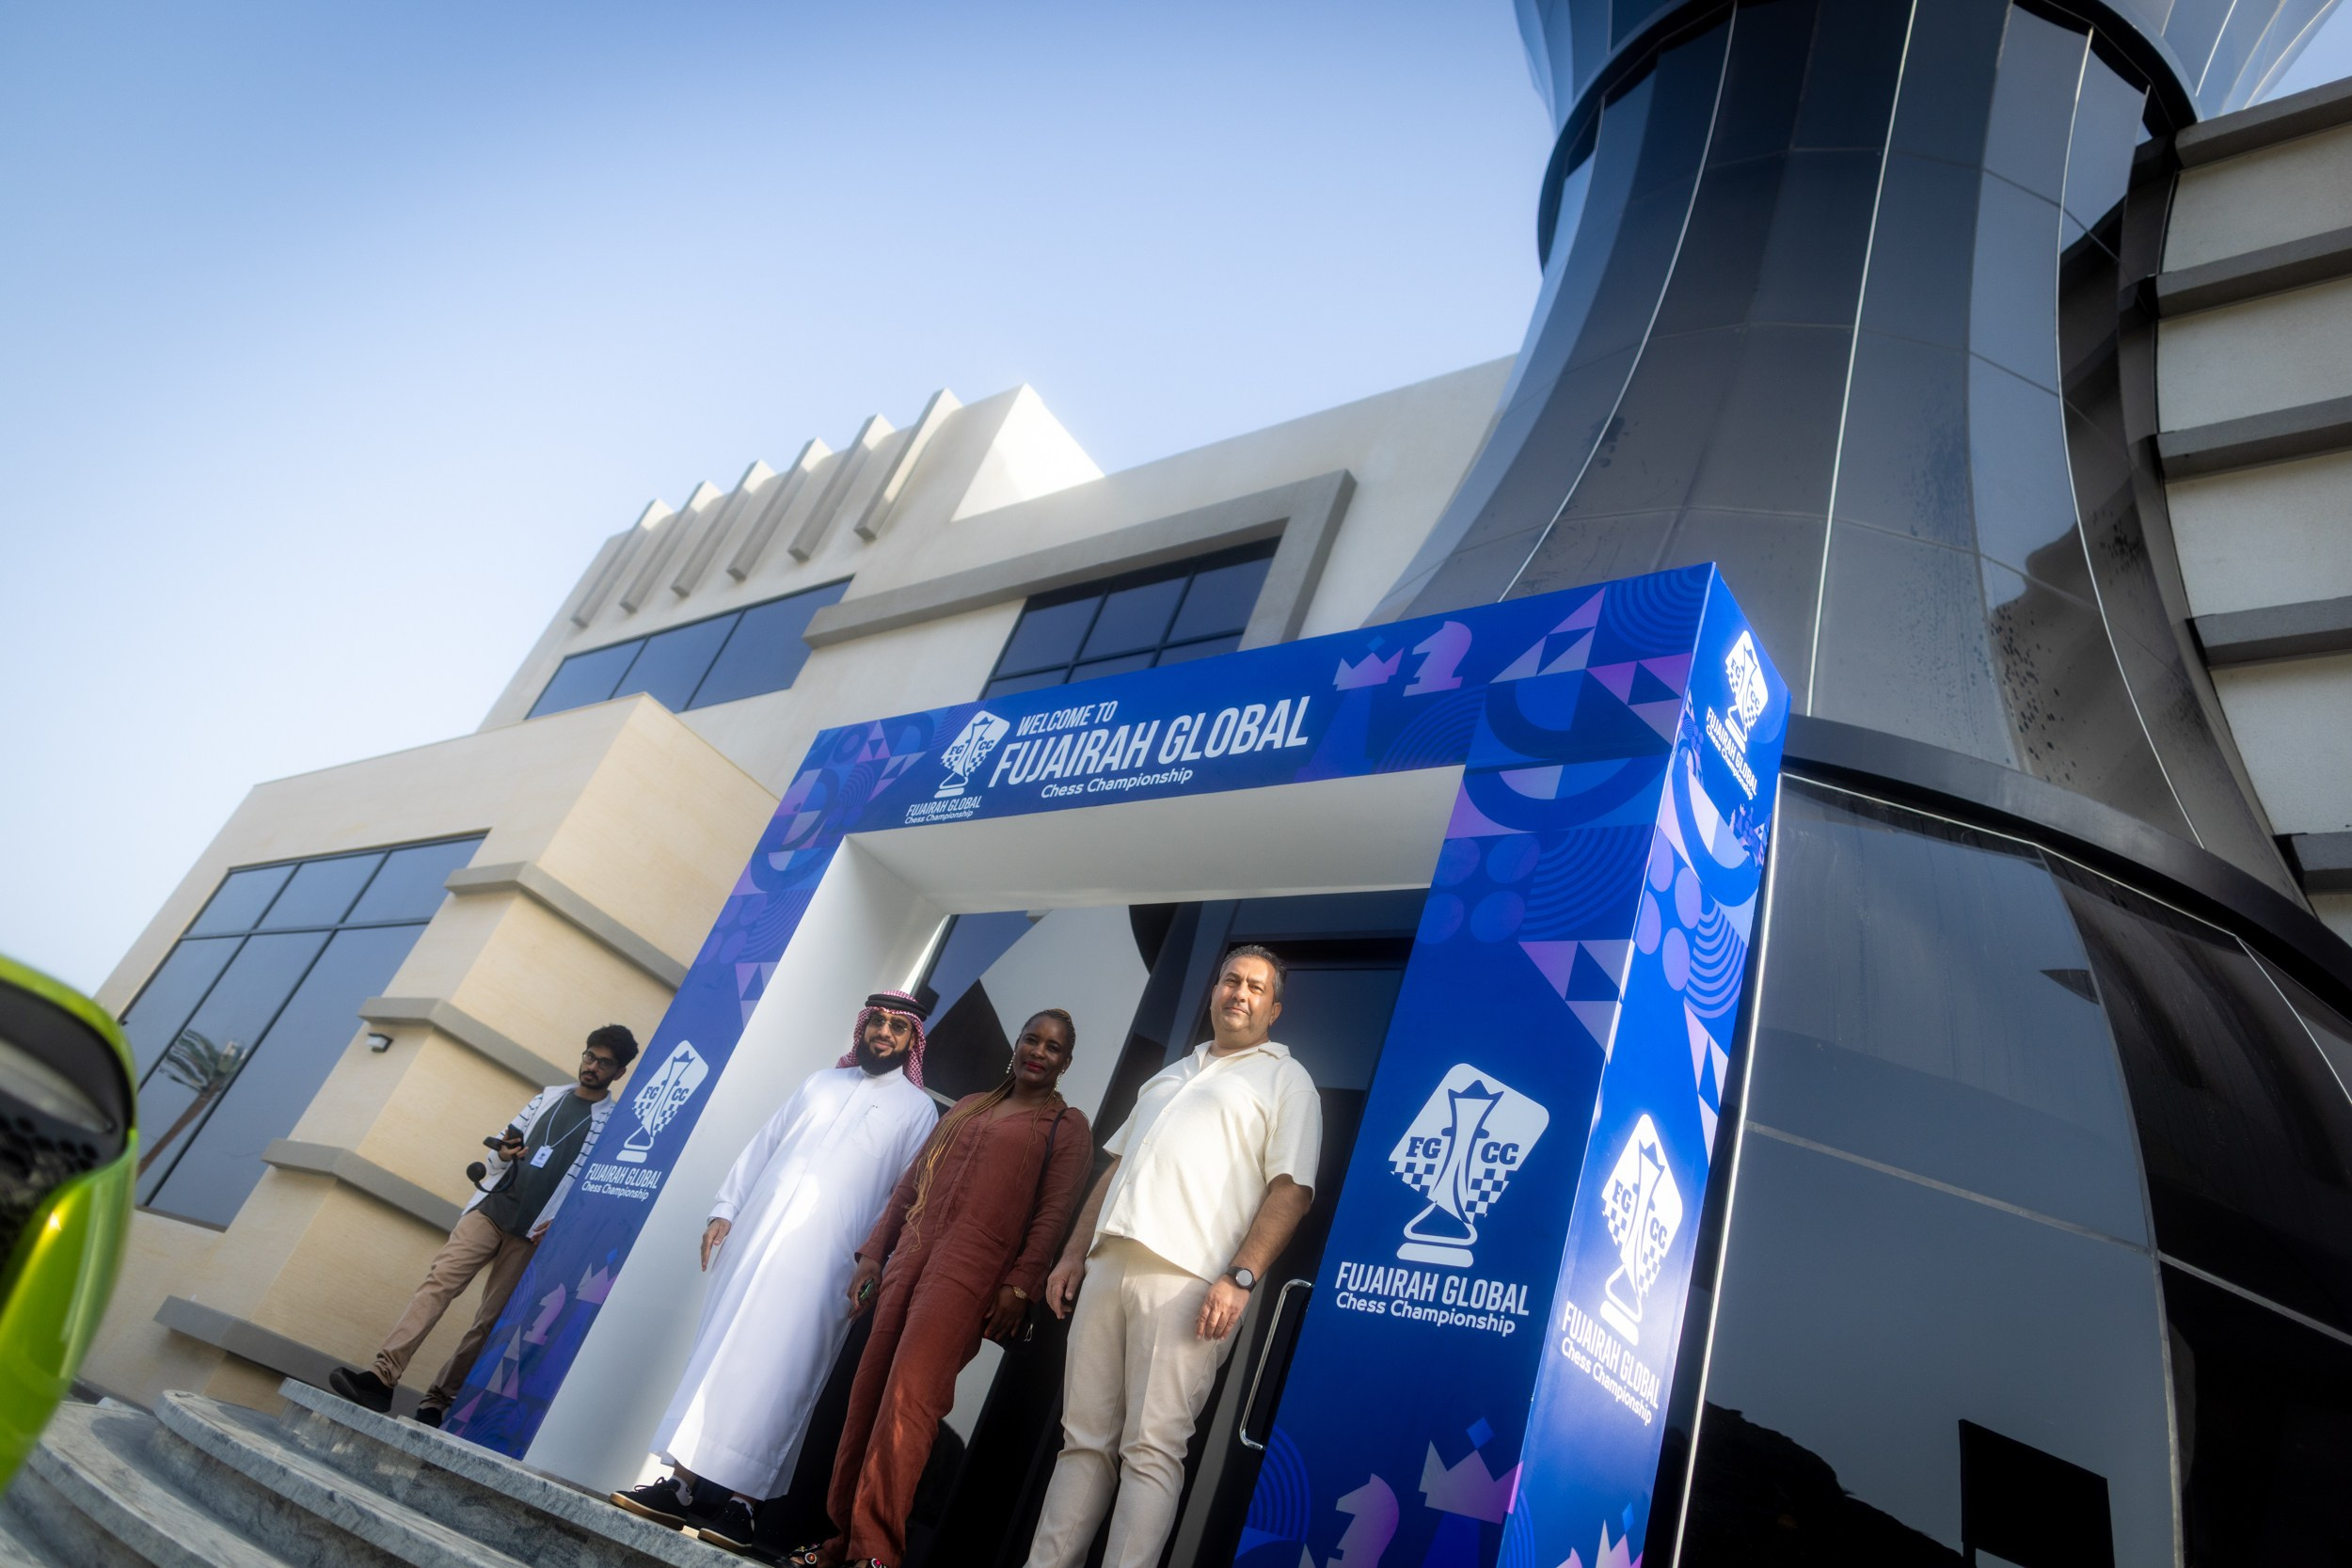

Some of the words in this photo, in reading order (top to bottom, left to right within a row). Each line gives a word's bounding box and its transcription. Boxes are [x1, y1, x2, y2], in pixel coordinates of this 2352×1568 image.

[1016, 705, 1093, 736] WELCOME
[1093, 701, 1119, 725] TO
[948, 744, 964, 755] FG
[977, 739, 994, 751] CC
[988, 720, 1160, 788] FUJAIRAH
[1158, 696, 1311, 764] GLOBAL
[1707, 705, 1737, 761] FUJAIRAH
[1735, 752, 1757, 796] GLOBAL
[1041, 782, 1083, 799] Chess
[1087, 768, 1193, 793] Championship
[904, 816, 926, 825] Chess
[926, 809, 974, 821] Championship
[905, 800, 949, 817] FUJAIRAH
[947, 795, 982, 812] GLOBAL
[643, 1086, 660, 1100] FG
[671, 1087, 690, 1101] CC
[1406, 1136, 1442, 1159] FG
[1480, 1142, 1519, 1165] CC
[581, 1180, 601, 1194] Chess
[601, 1183, 649, 1202] Championship
[584, 1163, 628, 1184] FUJAIRAH
[624, 1167, 662, 1189] GLOBAL
[1612, 1179, 1632, 1214] FG
[1649, 1217, 1668, 1251] CC
[1335, 1261, 1439, 1302] FUJAIRAH
[1441, 1275, 1530, 1316] GLOBAL
[1336, 1291, 1386, 1314] Chess
[1391, 1300, 1516, 1338] Championship
[1562, 1300, 1623, 1374] FUJAIRAH
[1620, 1350, 1661, 1409] GLOBAL
[1562, 1337, 1591, 1375] Chess
[1593, 1365, 1652, 1426] Championship
